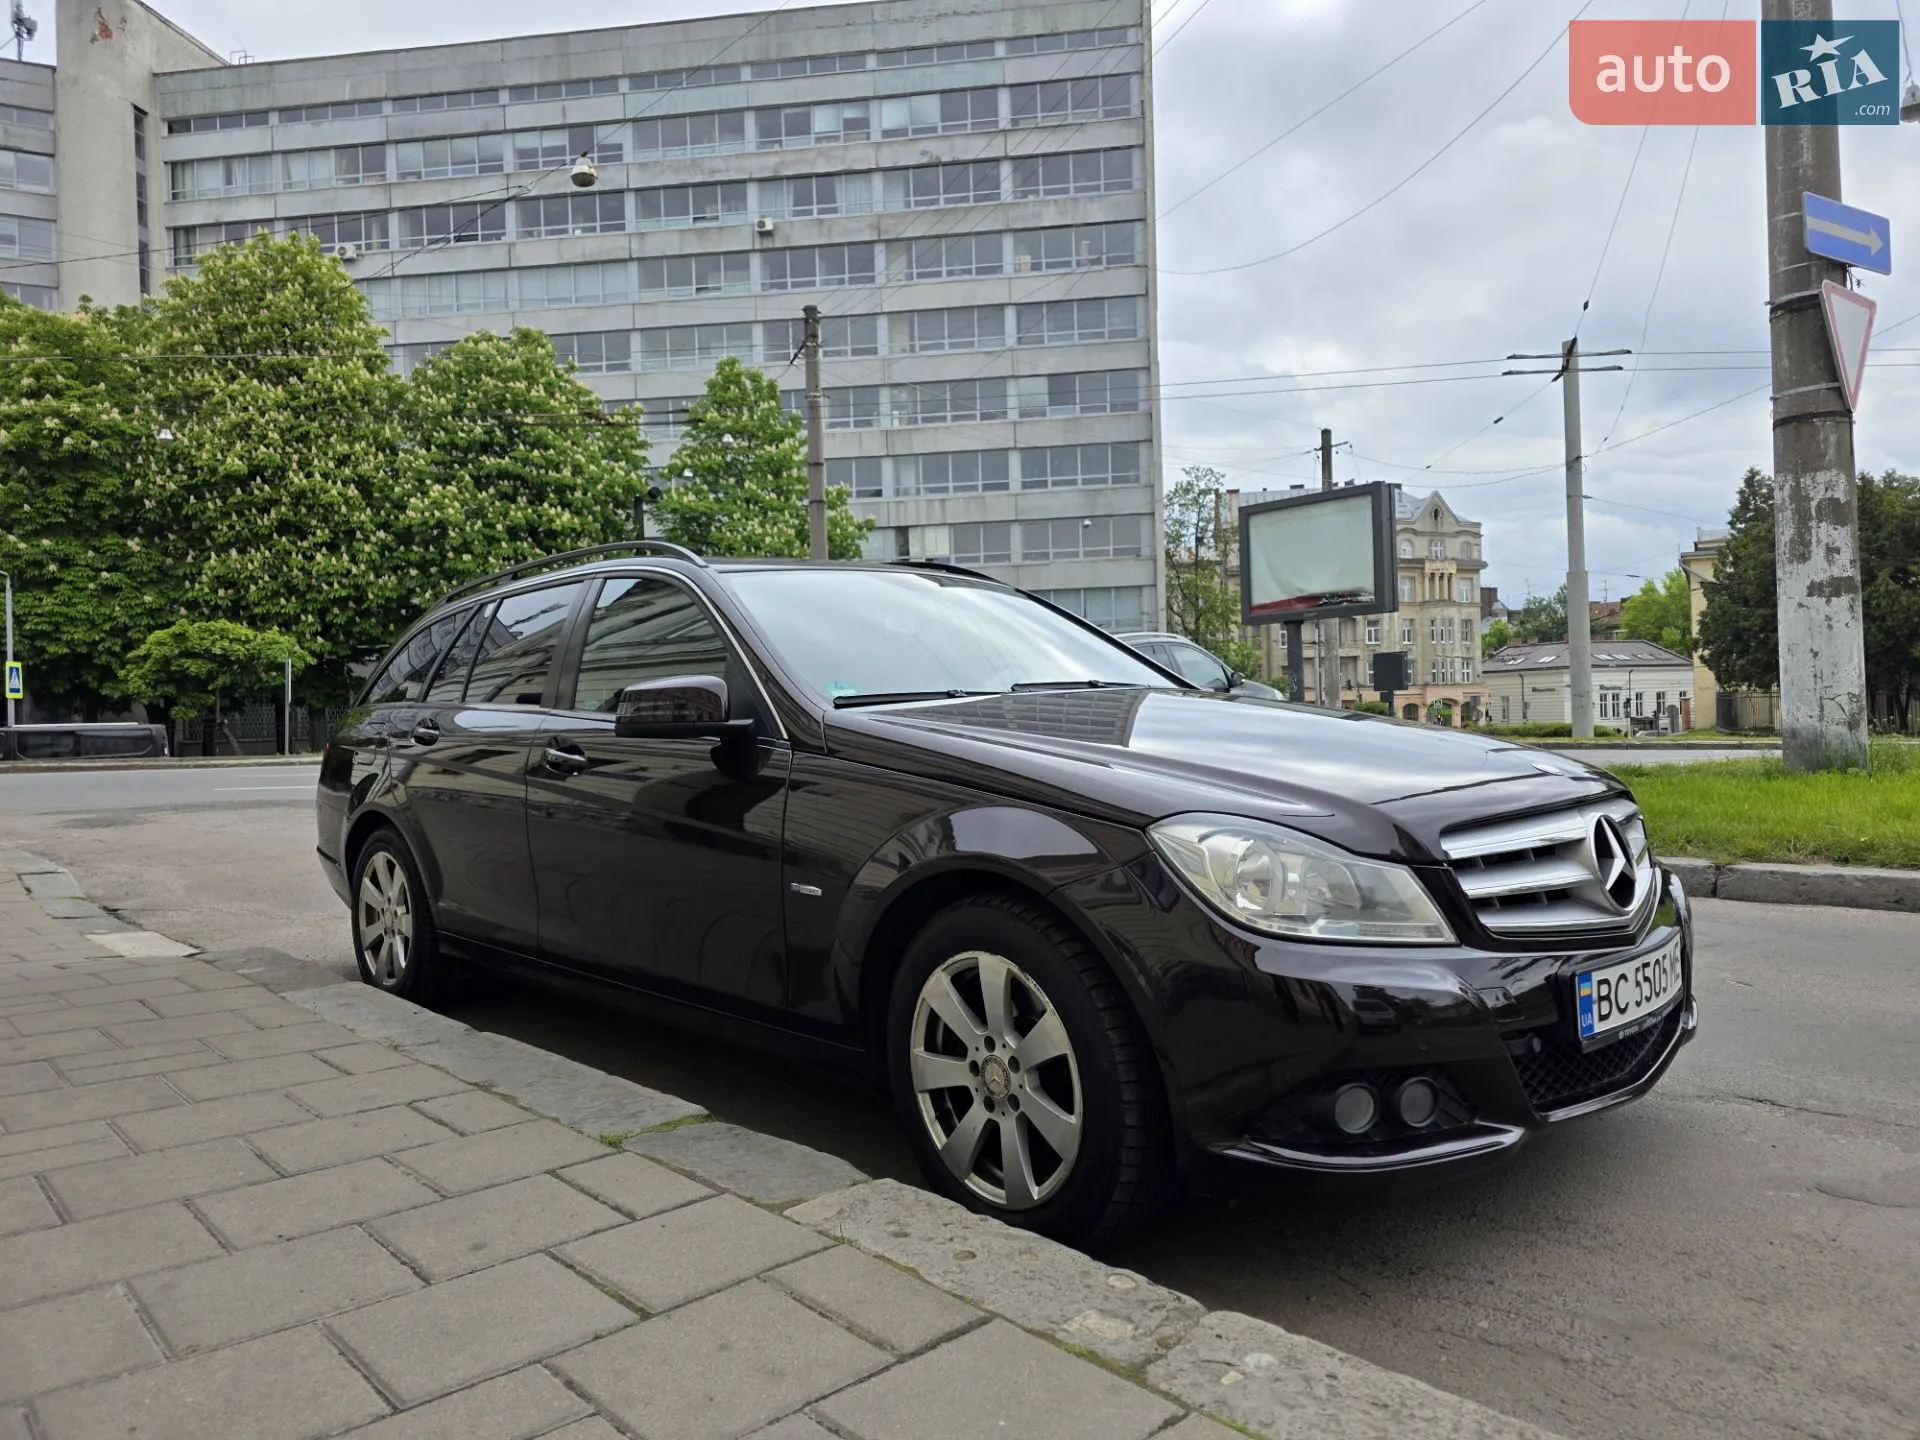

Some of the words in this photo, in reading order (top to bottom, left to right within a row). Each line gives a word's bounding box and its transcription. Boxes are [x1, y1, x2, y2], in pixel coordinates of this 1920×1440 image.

[1597, 973, 1630, 1022] BC
[1635, 953, 1668, 1008] 5505
[1582, 1012, 1593, 1027] UA
